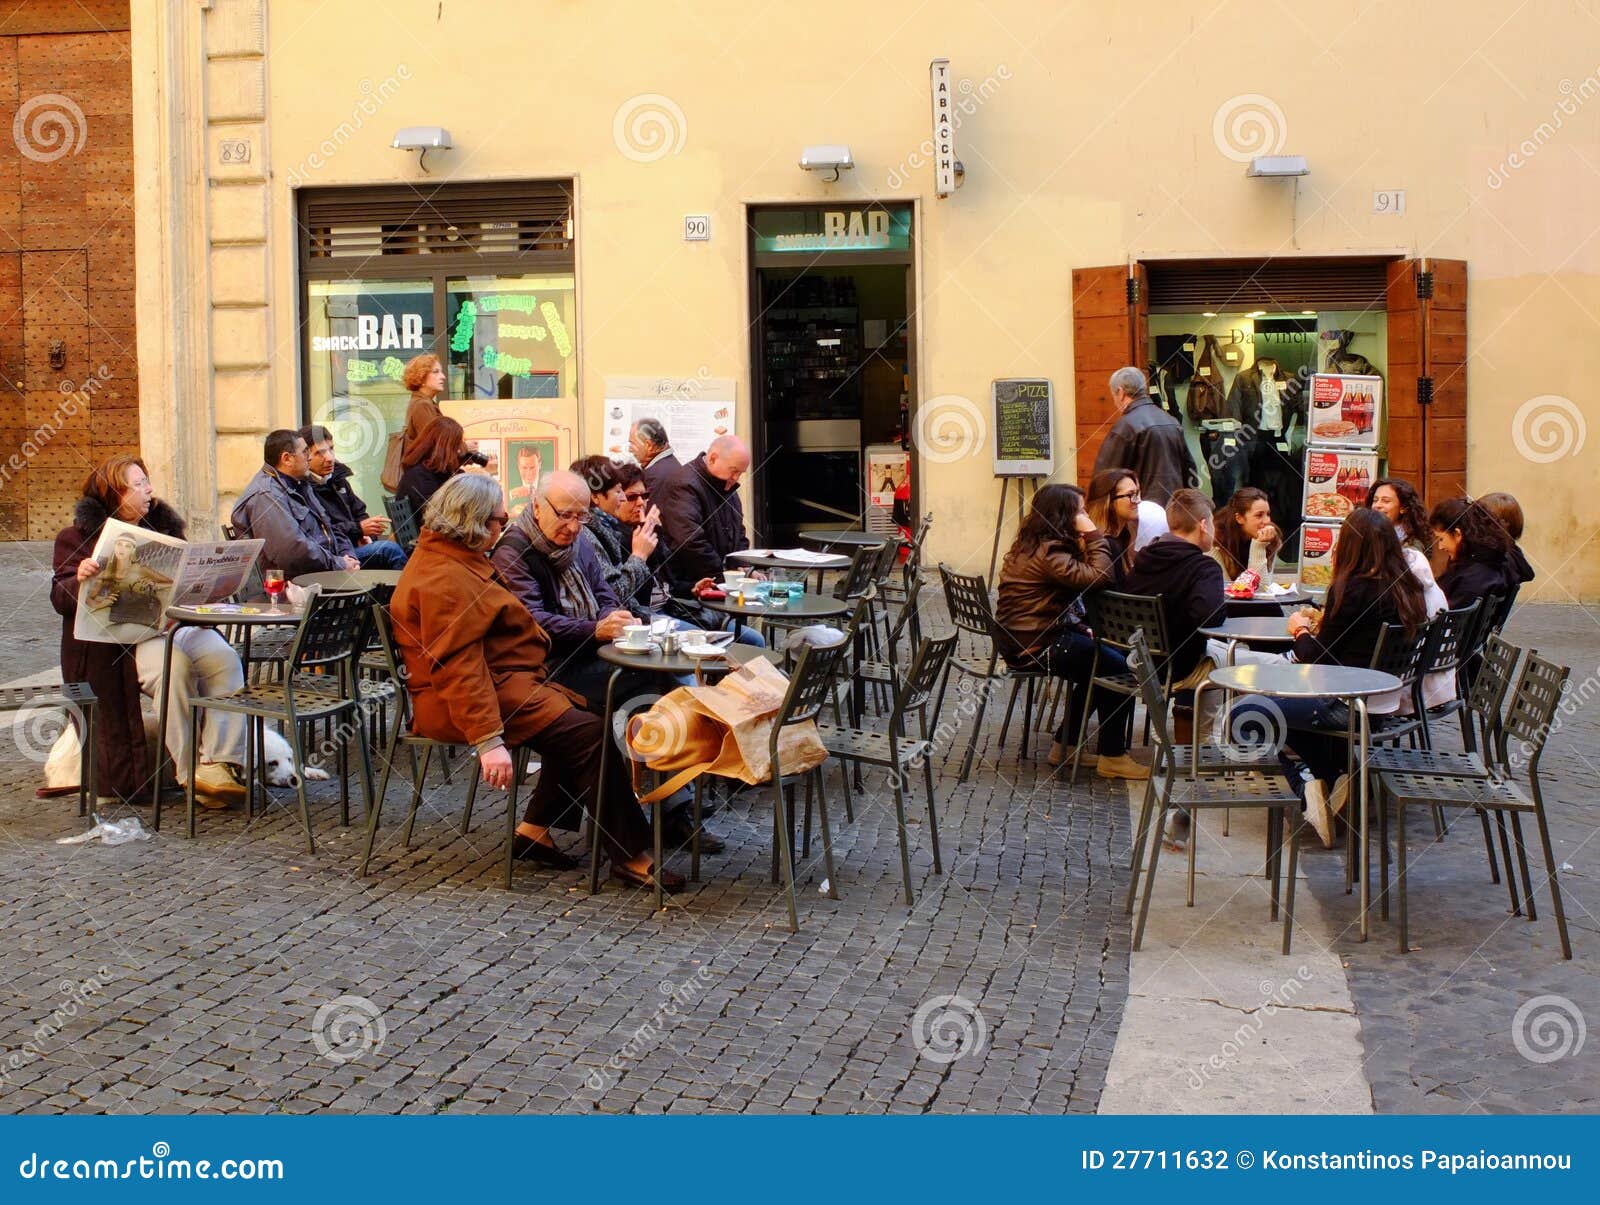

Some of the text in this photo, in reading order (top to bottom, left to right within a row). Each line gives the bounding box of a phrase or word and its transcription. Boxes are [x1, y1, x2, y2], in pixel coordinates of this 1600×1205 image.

[938, 67, 950, 185] TABACCHI
[222, 142, 247, 161] 89
[1376, 192, 1400, 212] 91
[687, 221, 705, 235] 90
[824, 210, 890, 247] BAR
[312, 334, 359, 352] SNACK
[358, 313, 423, 350] BAR
[1018, 384, 1049, 398] PIZZE
